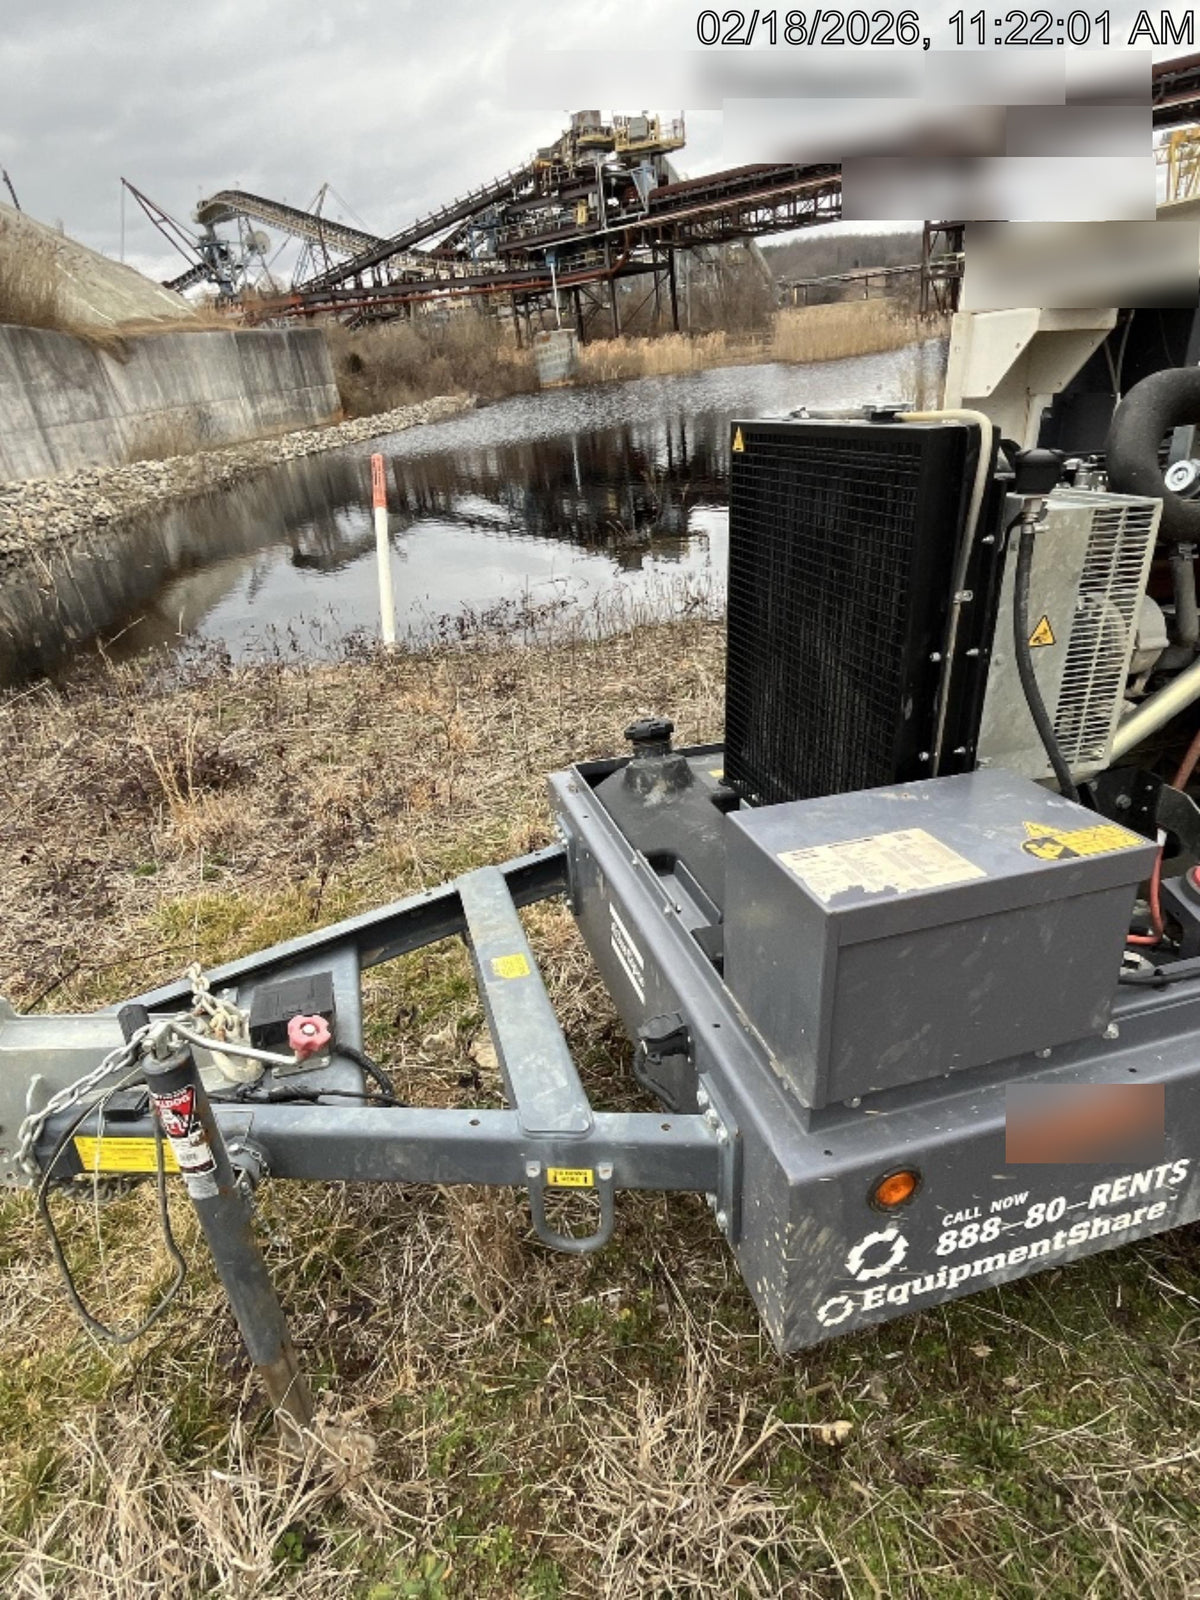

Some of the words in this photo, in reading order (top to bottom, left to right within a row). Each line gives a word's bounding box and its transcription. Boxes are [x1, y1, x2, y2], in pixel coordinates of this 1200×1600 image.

[935, 1158, 1191, 1256] 888-80-RENTS
[942, 1206, 982, 1227] CALL
[990, 1190, 1030, 1213] NOW
[860, 1201, 1168, 1312] EquipmentShare
